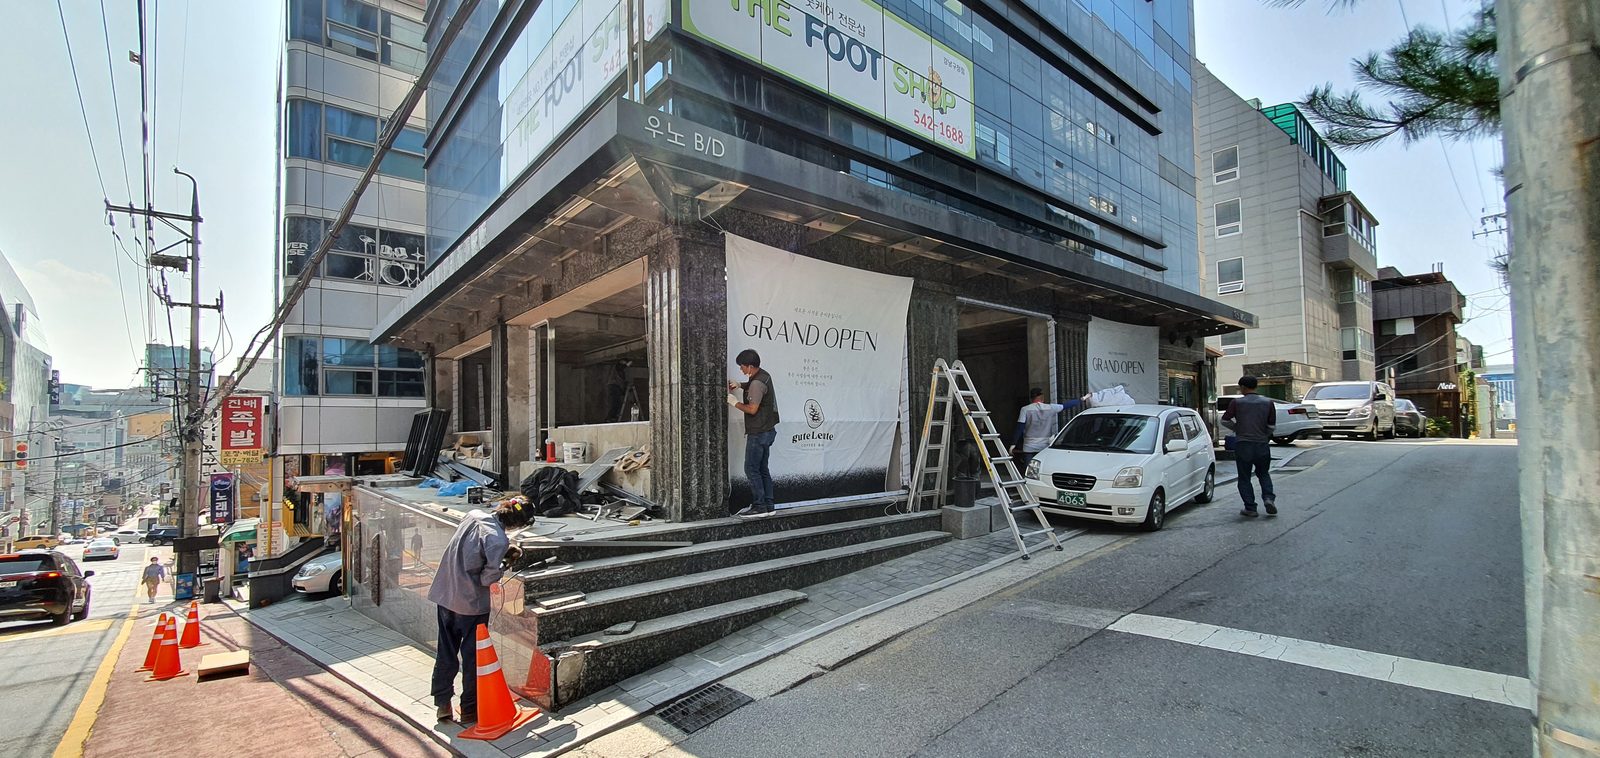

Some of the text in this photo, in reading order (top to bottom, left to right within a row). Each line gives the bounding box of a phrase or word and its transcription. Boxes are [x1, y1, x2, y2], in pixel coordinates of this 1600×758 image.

[838, 11, 866, 37] 전문샵
[805, 13, 882, 80] FOOT
[893, 63, 956, 114] SHOP
[544, 50, 585, 118] FOOT
[644, 115, 725, 158] 우노 B/D
[913, 109, 964, 144] 542-1688
[742, 313, 820, 347] GRAND
[824, 327, 878, 352] OPEN
[1092, 356, 1145, 375] GRAND OPEN
[228, 399, 257, 409] 진배
[228, 410, 257, 447] 족발
[1059, 495, 1085, 506] 4063
